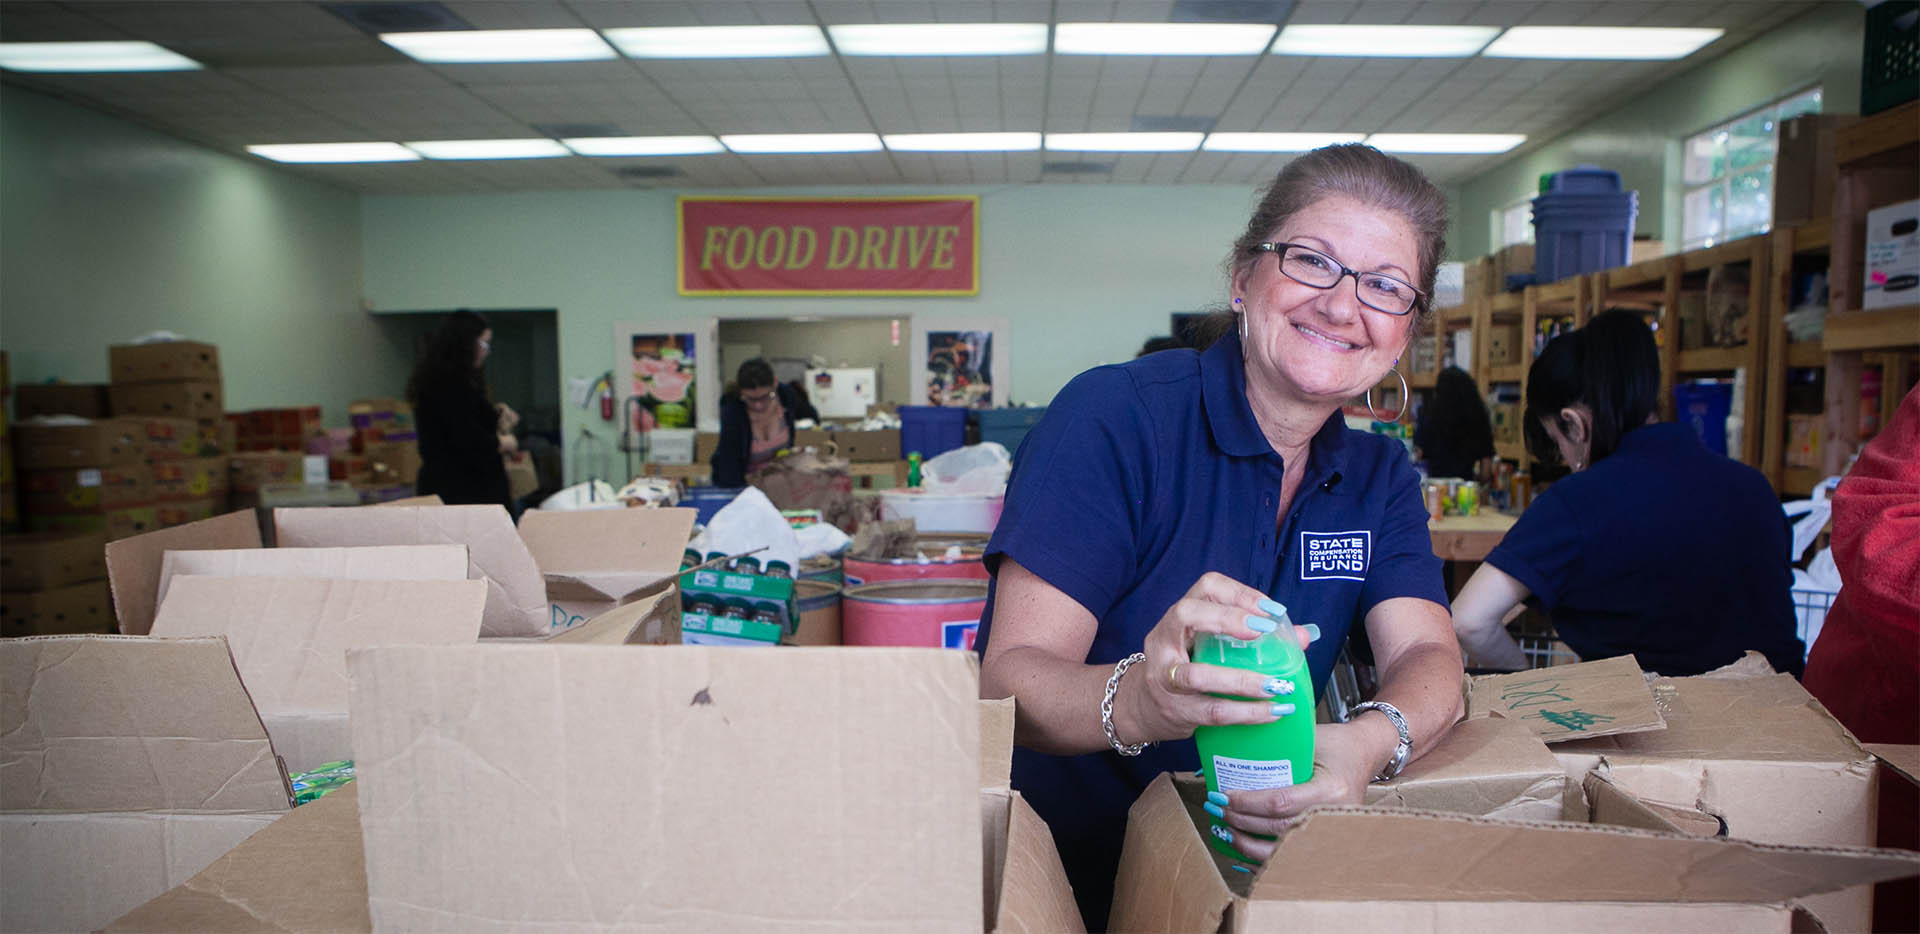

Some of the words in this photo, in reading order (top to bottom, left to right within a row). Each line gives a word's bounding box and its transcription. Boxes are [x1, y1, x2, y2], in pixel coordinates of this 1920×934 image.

[702, 225, 817, 270] FOOD
[824, 225, 960, 270] DRIVE
[1309, 538, 1363, 549] STATE
[1310, 560, 1363, 572] FUND
